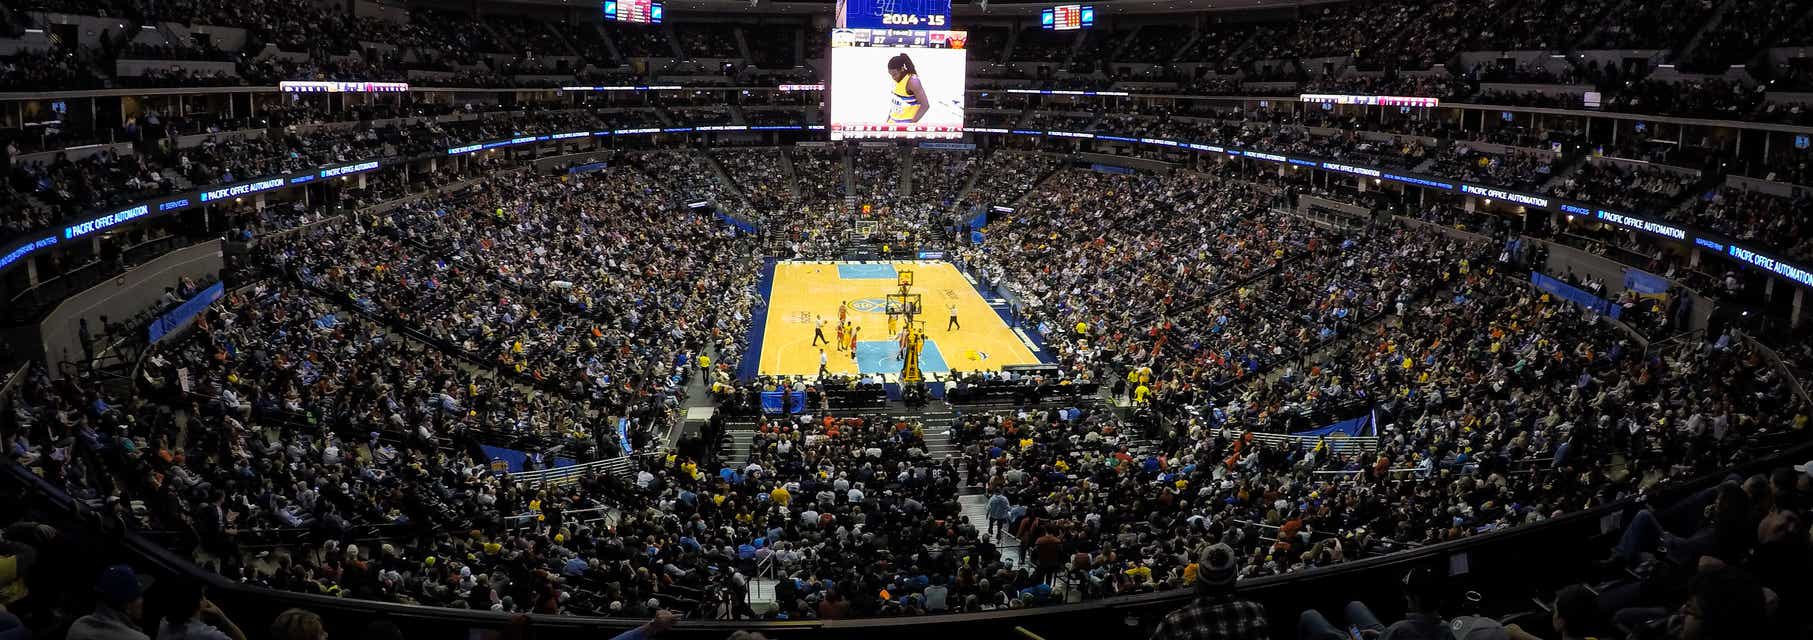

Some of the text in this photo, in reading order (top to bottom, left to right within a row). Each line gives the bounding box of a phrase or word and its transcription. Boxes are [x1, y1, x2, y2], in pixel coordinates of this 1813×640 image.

[883, 14, 919, 25] 2014
[928, 15, 945, 25] 15
[208, 188, 229, 200] PACIFIC
[230, 184, 250, 196] OFFICE
[250, 178, 284, 192] AUTOMATION
[1468, 186, 1548, 207] PACIFIC OFFICE AUTOMATION
[72, 205, 149, 236] PACIFIC OFFICE AUTOMATION
[1604, 212, 1686, 240] PACIFIC OFFICE AUTOMATION
[1735, 247, 1813, 287] PACIFIC OFFICE AUTOMATION
